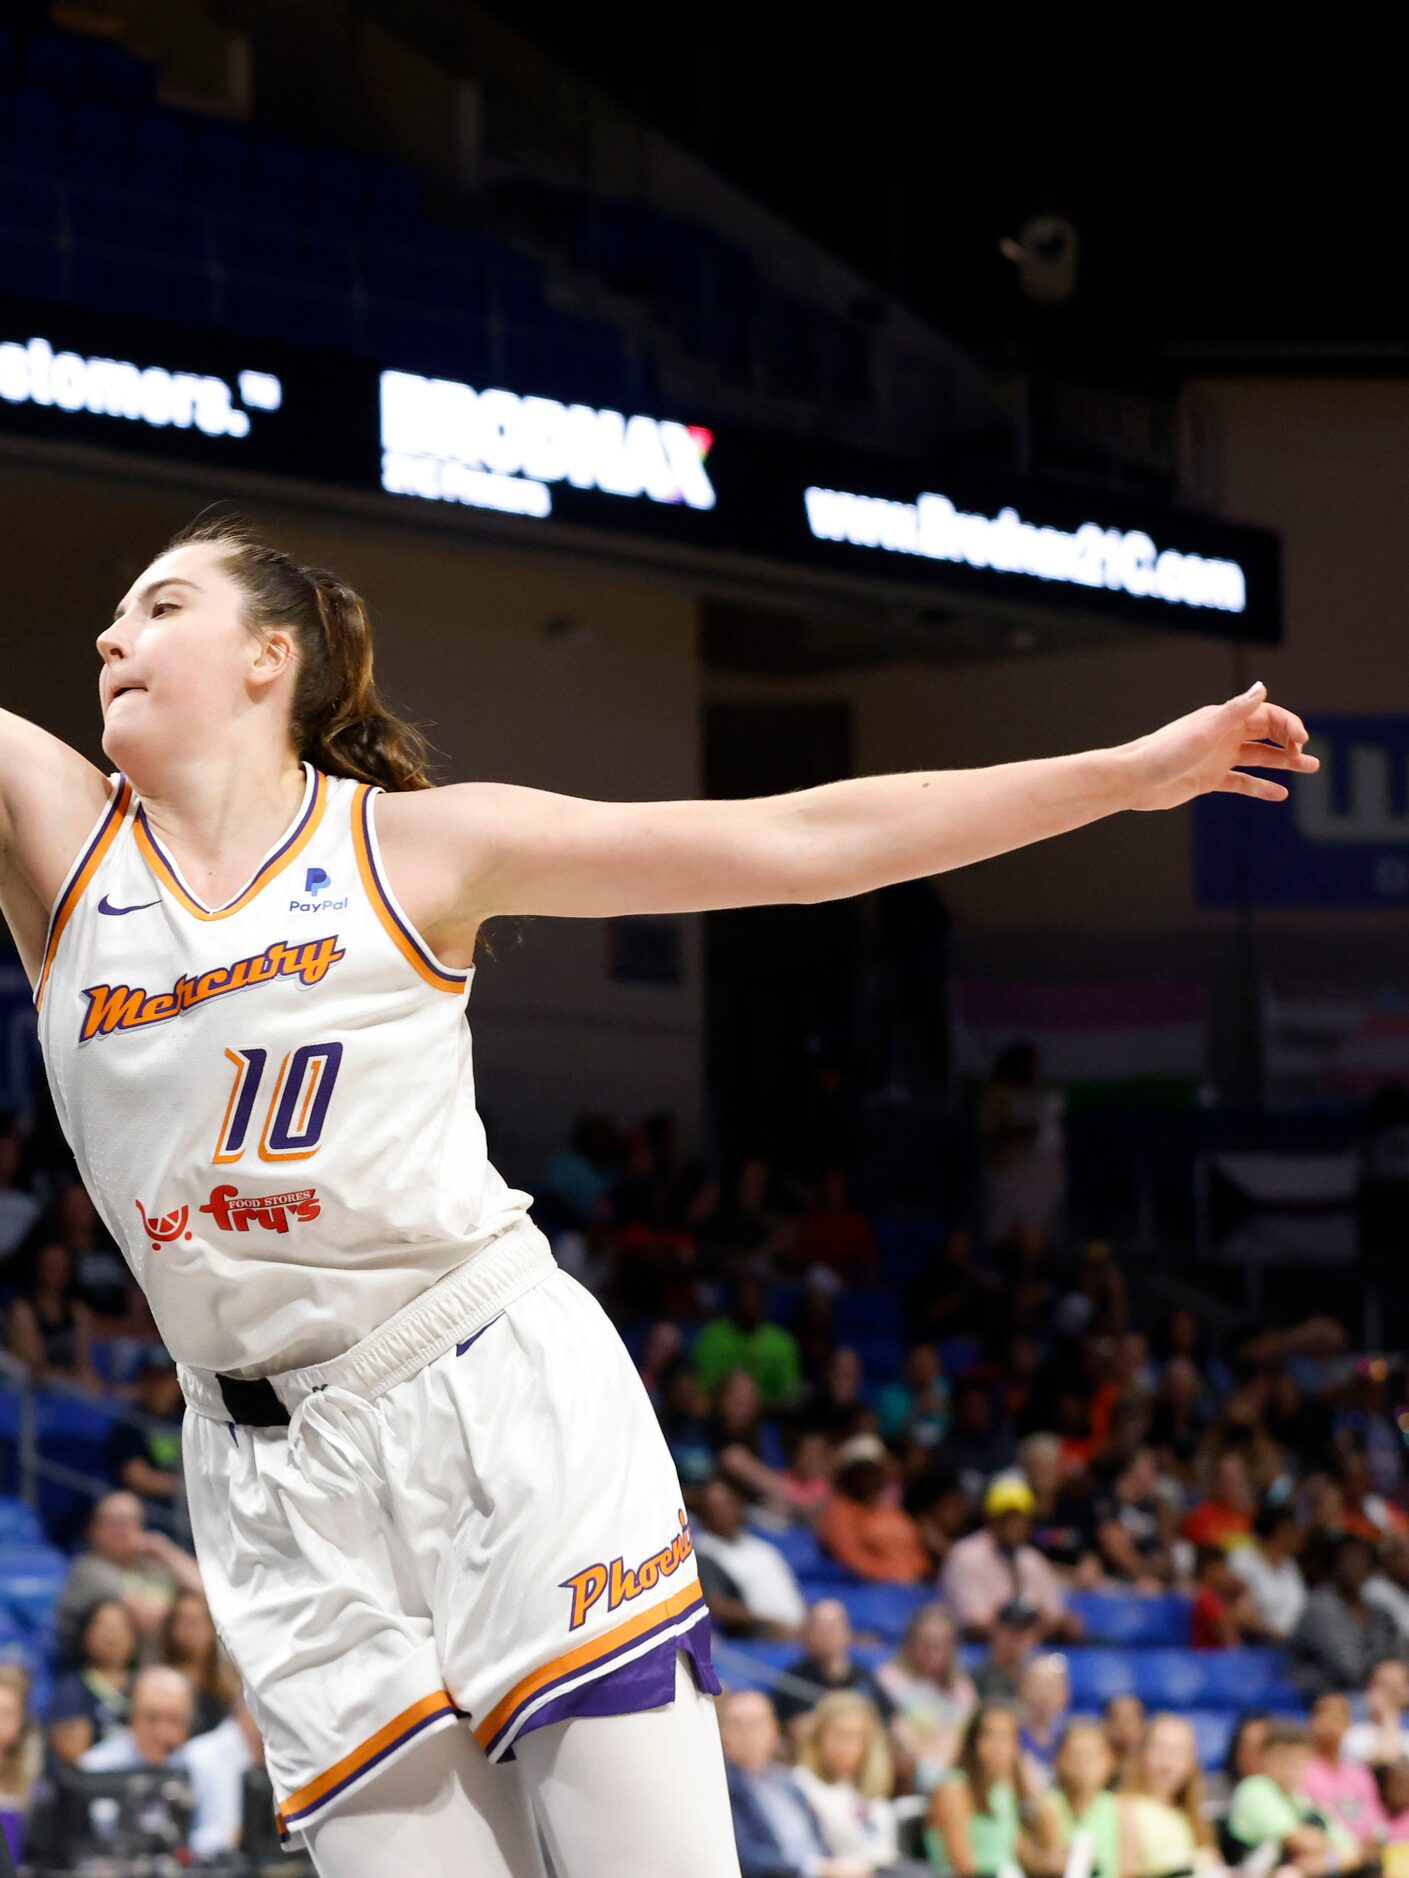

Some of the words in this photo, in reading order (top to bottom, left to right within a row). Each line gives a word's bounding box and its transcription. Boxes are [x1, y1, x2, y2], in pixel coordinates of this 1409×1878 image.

[289, 897, 348, 913] PayPal
[78, 934, 346, 1045] Mercury
[212, 1041, 344, 1165] 10
[199, 1184, 321, 1234] fry's
[229, 1199, 261, 1210] FOOD
[264, 1190, 312, 1207] STORES
